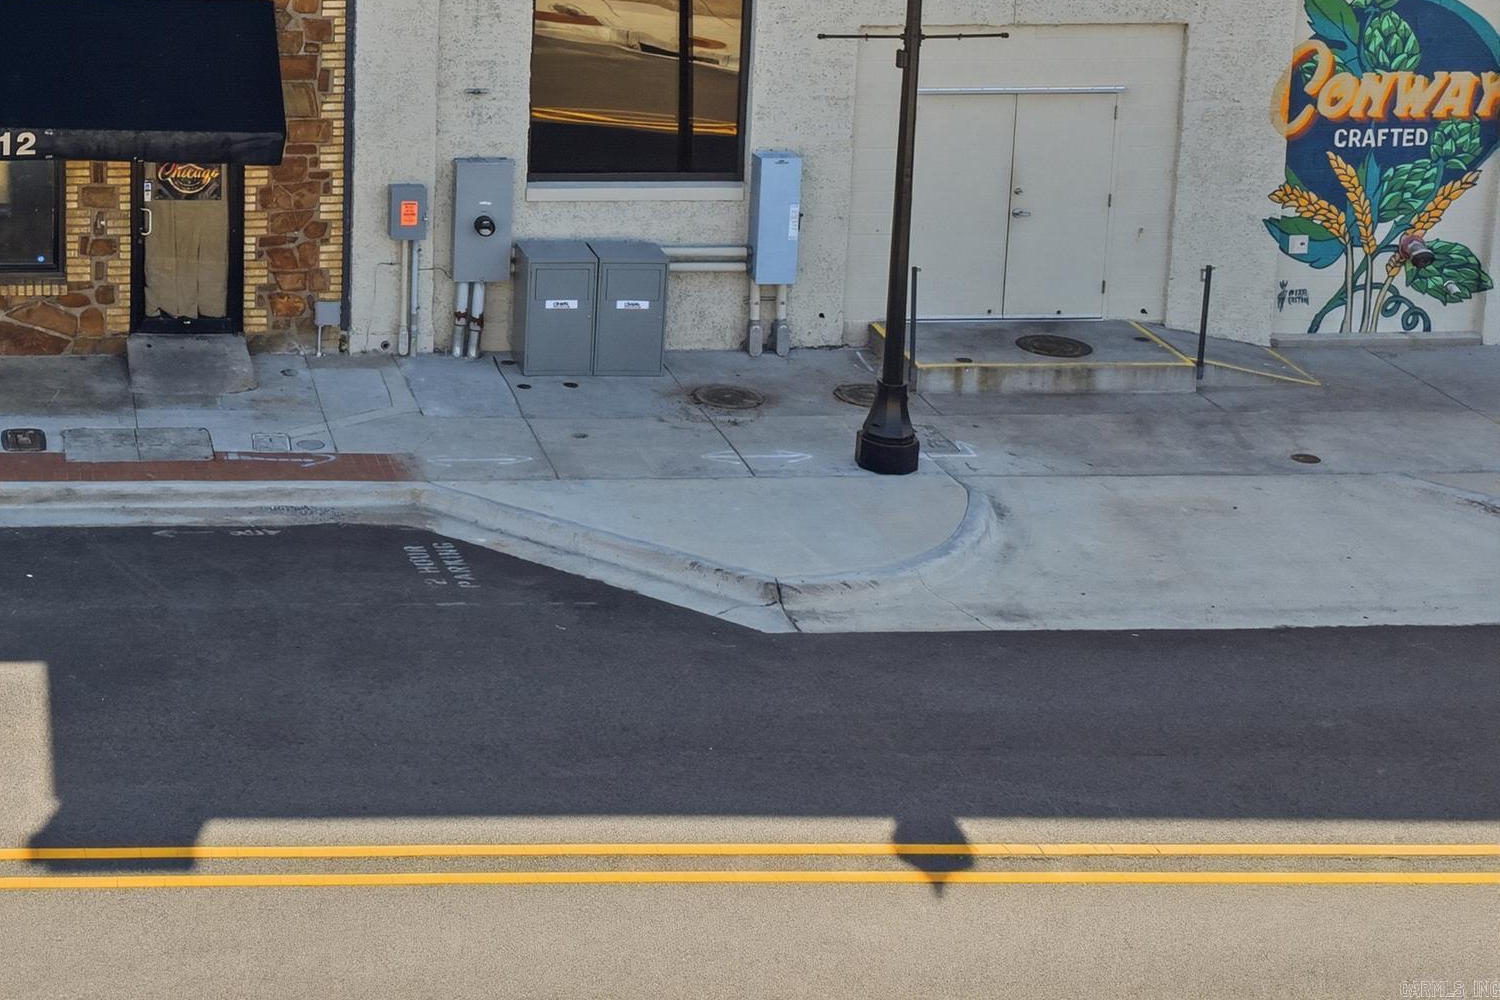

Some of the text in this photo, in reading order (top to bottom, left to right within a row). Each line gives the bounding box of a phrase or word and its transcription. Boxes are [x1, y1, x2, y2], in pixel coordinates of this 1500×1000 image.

[1334, 128, 1428, 148] CRAFTED
[158, 161, 220, 184] Chicago
[403, 545, 440, 573] HOUR
[432, 542, 482, 588] PARKING
